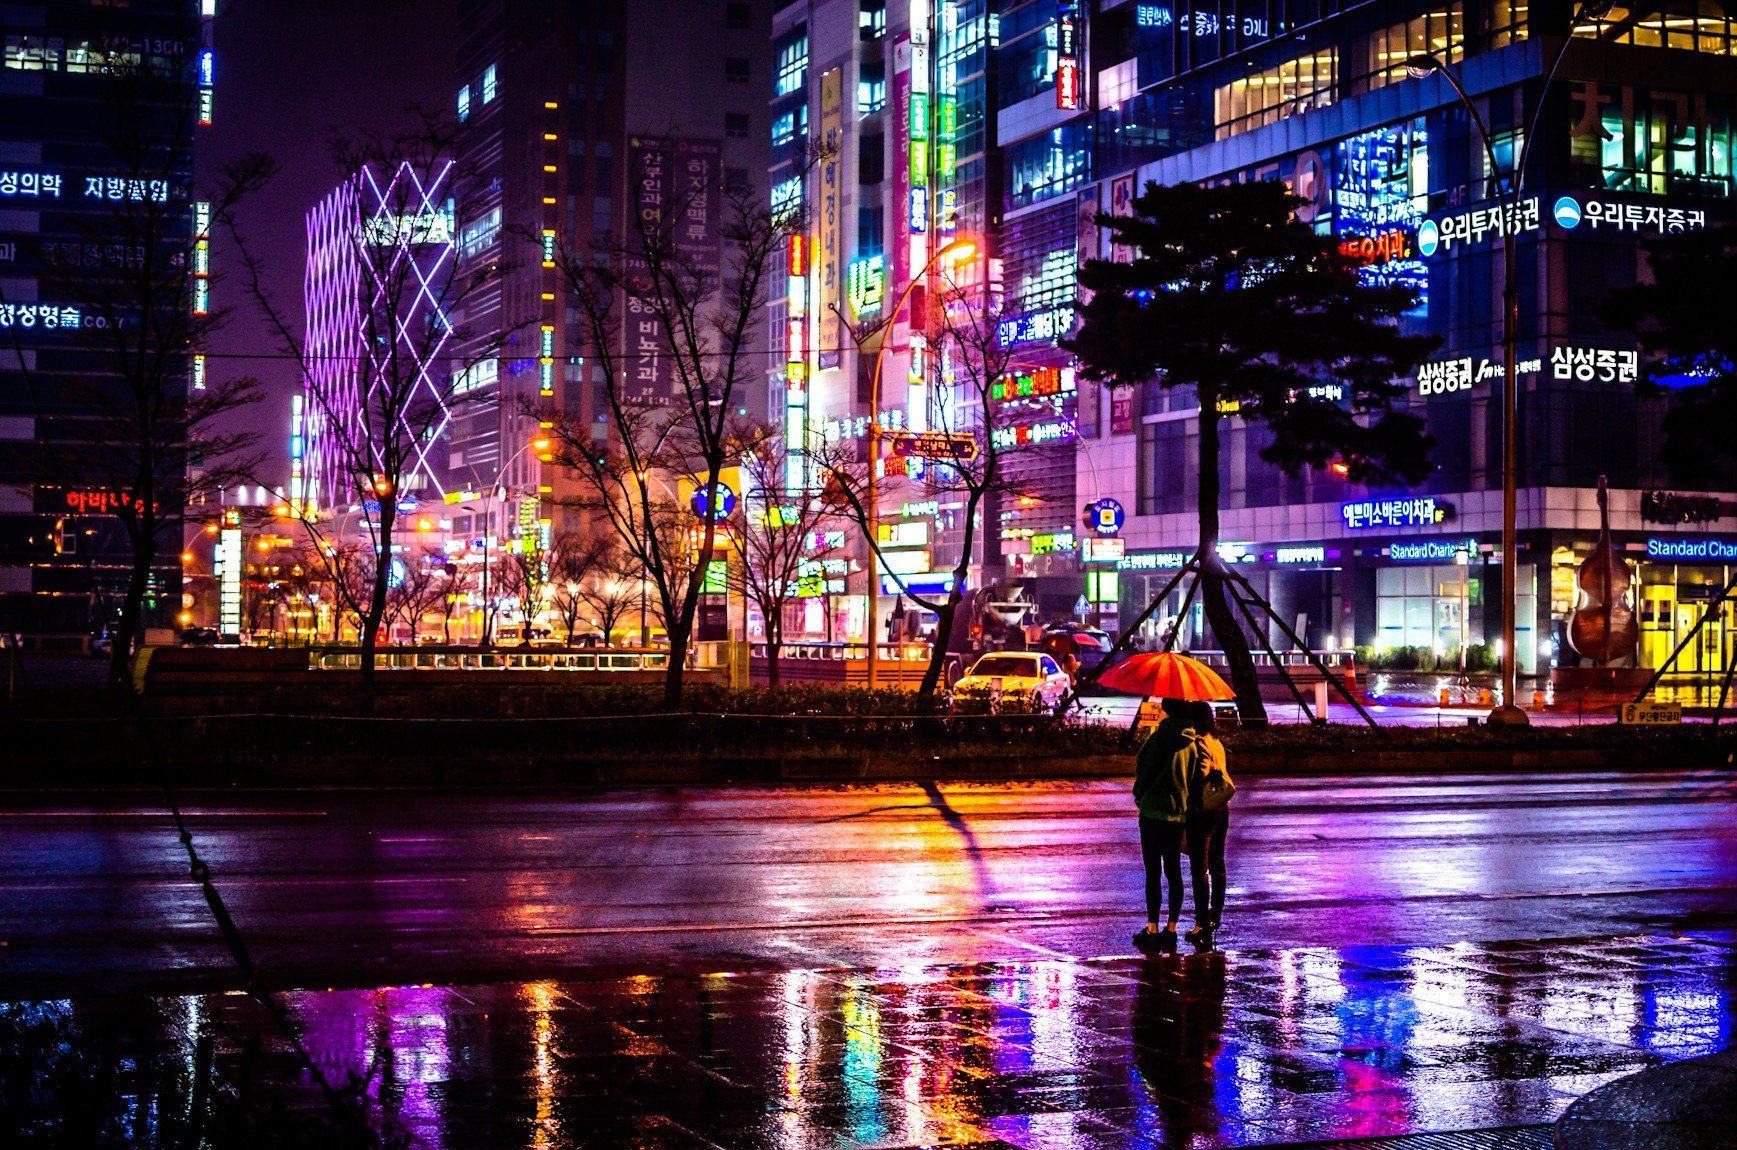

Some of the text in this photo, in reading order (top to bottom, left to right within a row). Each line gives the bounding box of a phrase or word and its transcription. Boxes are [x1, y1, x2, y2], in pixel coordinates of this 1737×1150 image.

[1439, 196, 1539, 250] 우리투자증권
[1584, 201, 1706, 235] 우리투자증권
[637, 320, 660, 382] 비뇨기과
[1550, 345, 1638, 383] 삼성증권
[1417, 356, 1473, 396] 삼성증권
[1343, 498, 1435, 528] 예쁜미소바른이치과
[1391, 542, 1428, 559] Standard
[1648, 539, 1706, 556] Standard
